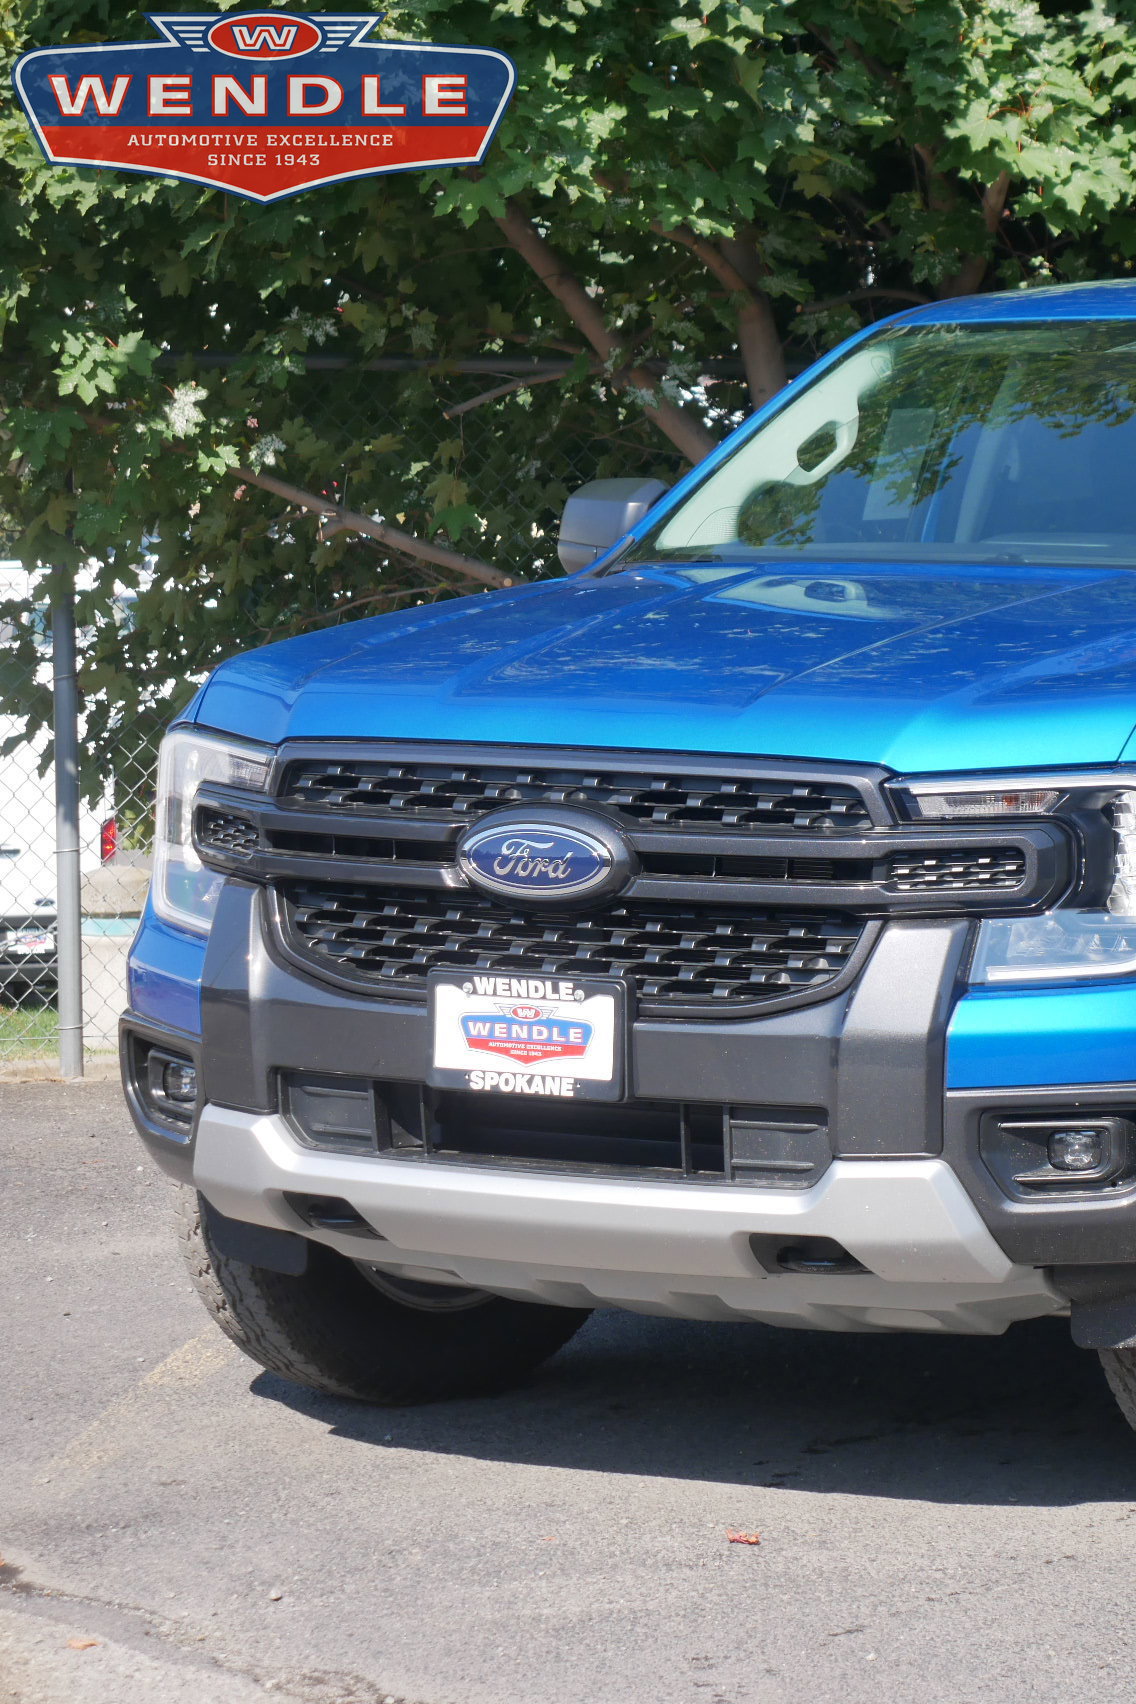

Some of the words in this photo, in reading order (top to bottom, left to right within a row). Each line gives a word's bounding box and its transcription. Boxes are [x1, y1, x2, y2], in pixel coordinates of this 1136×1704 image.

[493, 838, 574, 879] Ford
[473, 976, 575, 1001] WENDLE
[468, 1021, 583, 1042] WENDLE
[488, 1041, 526, 1049] AUTOMOTIVE
[469, 1070, 575, 1097] SPOKANE
